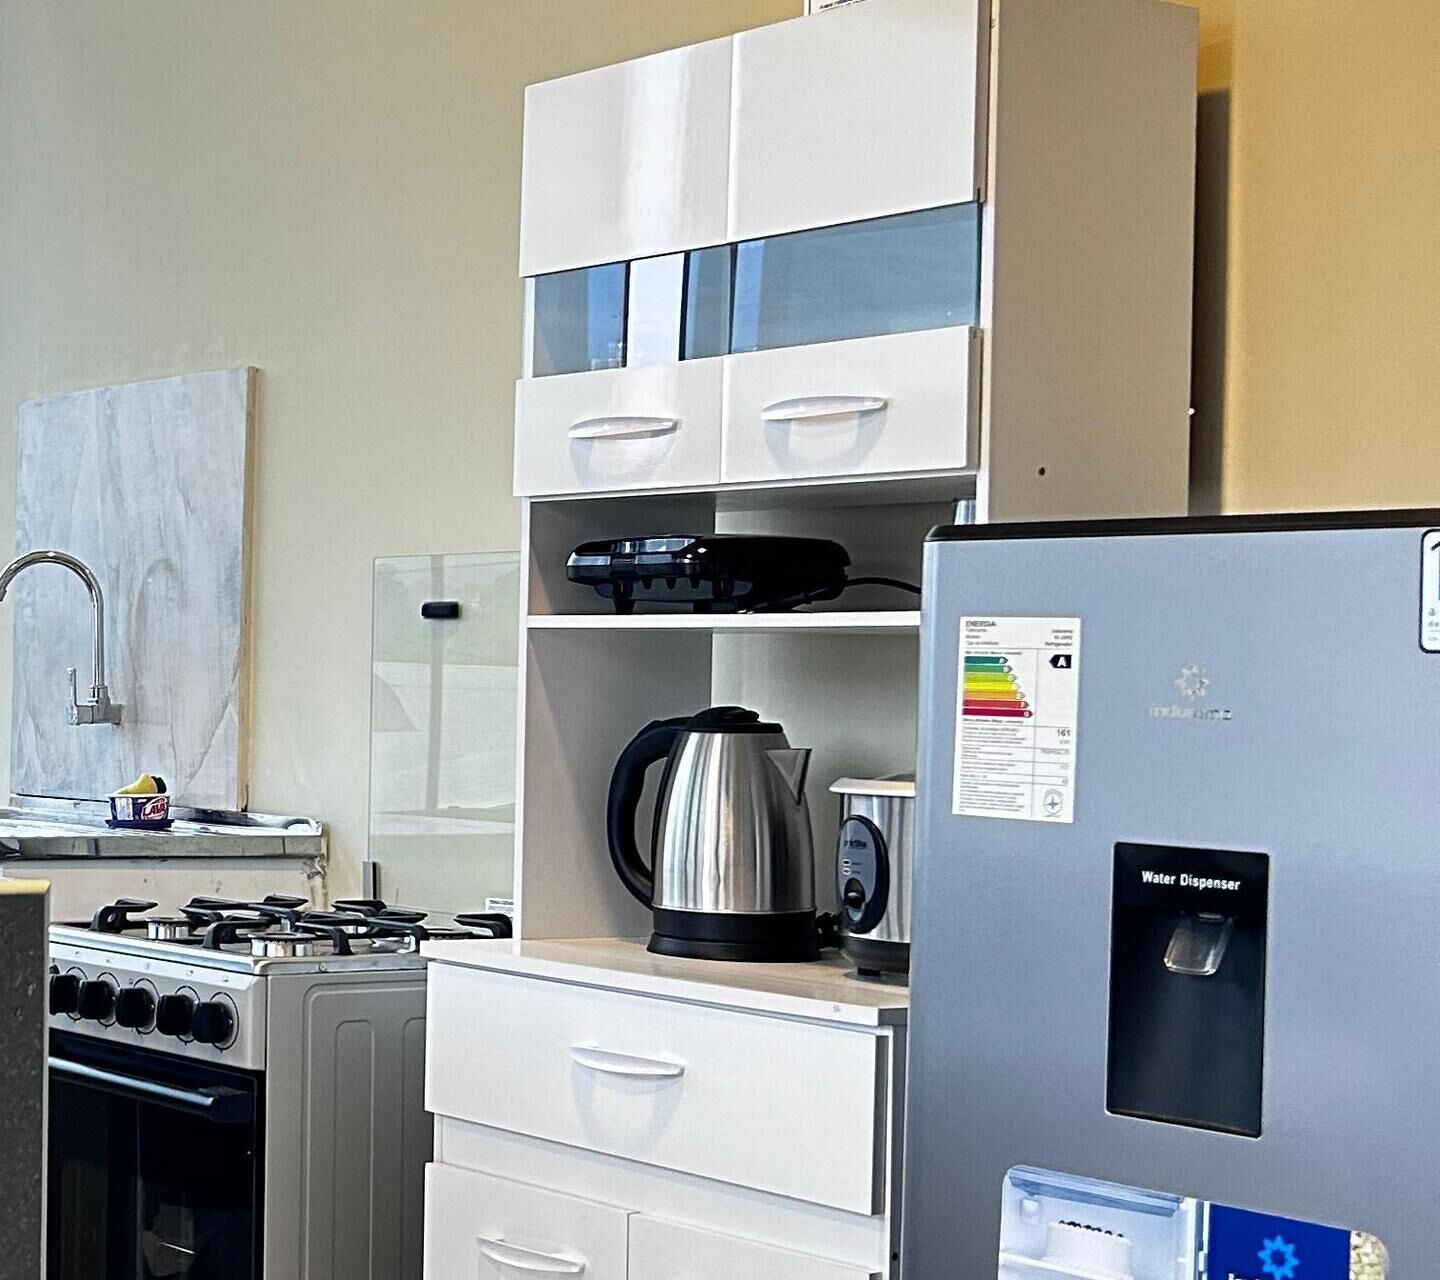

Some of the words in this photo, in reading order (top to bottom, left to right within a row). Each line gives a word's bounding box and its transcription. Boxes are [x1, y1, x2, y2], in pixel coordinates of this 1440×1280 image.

[1057, 656, 1067, 668] A
[1141, 870, 1177, 885] Water
[1180, 873, 1241, 891] Dispenser
